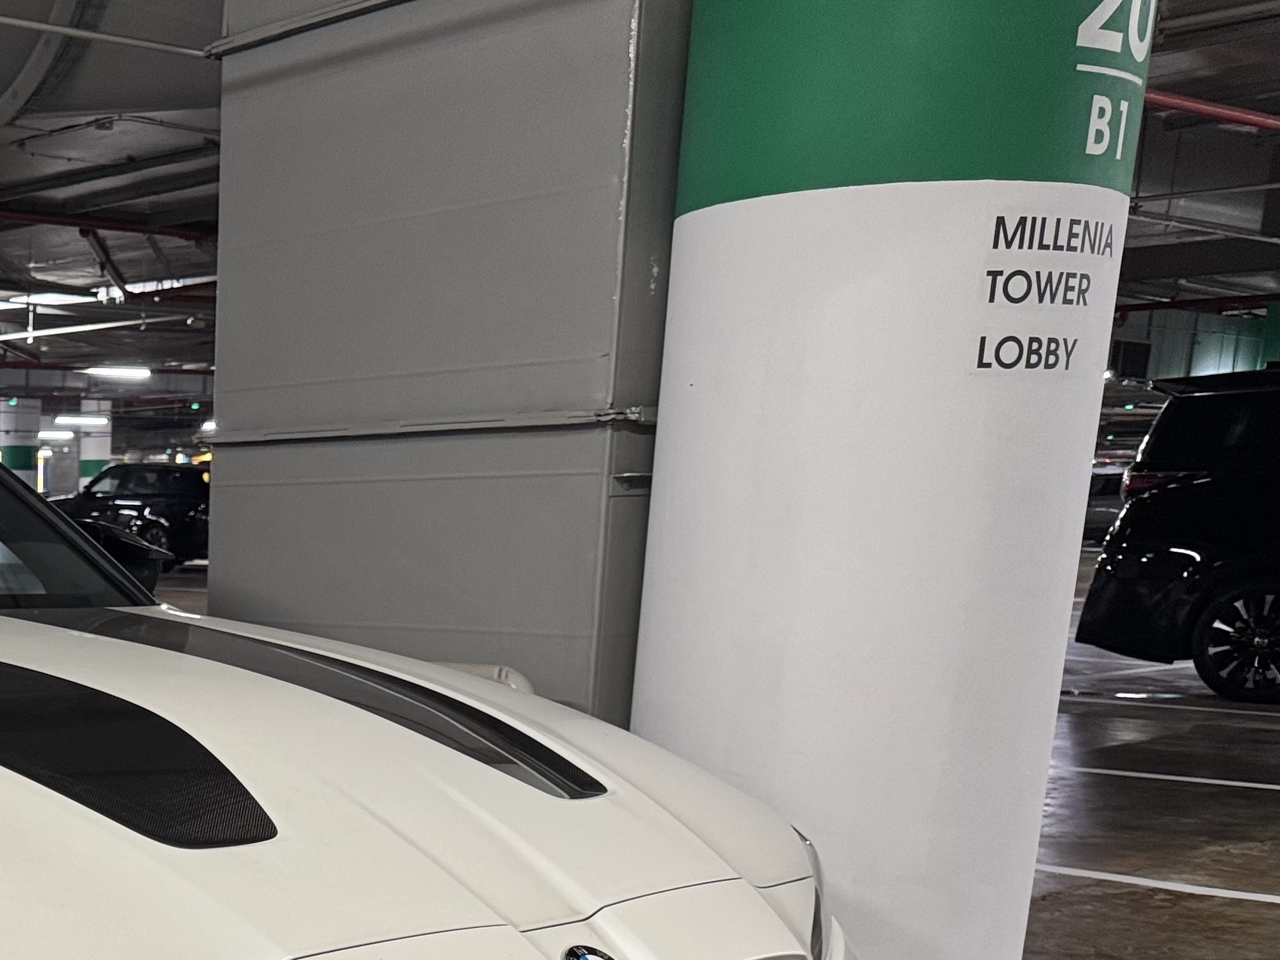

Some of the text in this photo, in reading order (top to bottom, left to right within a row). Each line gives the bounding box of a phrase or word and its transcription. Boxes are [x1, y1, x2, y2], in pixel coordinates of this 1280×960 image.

[1085, 94, 1129, 161] B1
[991, 215, 1115, 259] MILLENIA
[985, 270, 1092, 308] TOWER
[976, 335, 1078, 372] LOBBY
